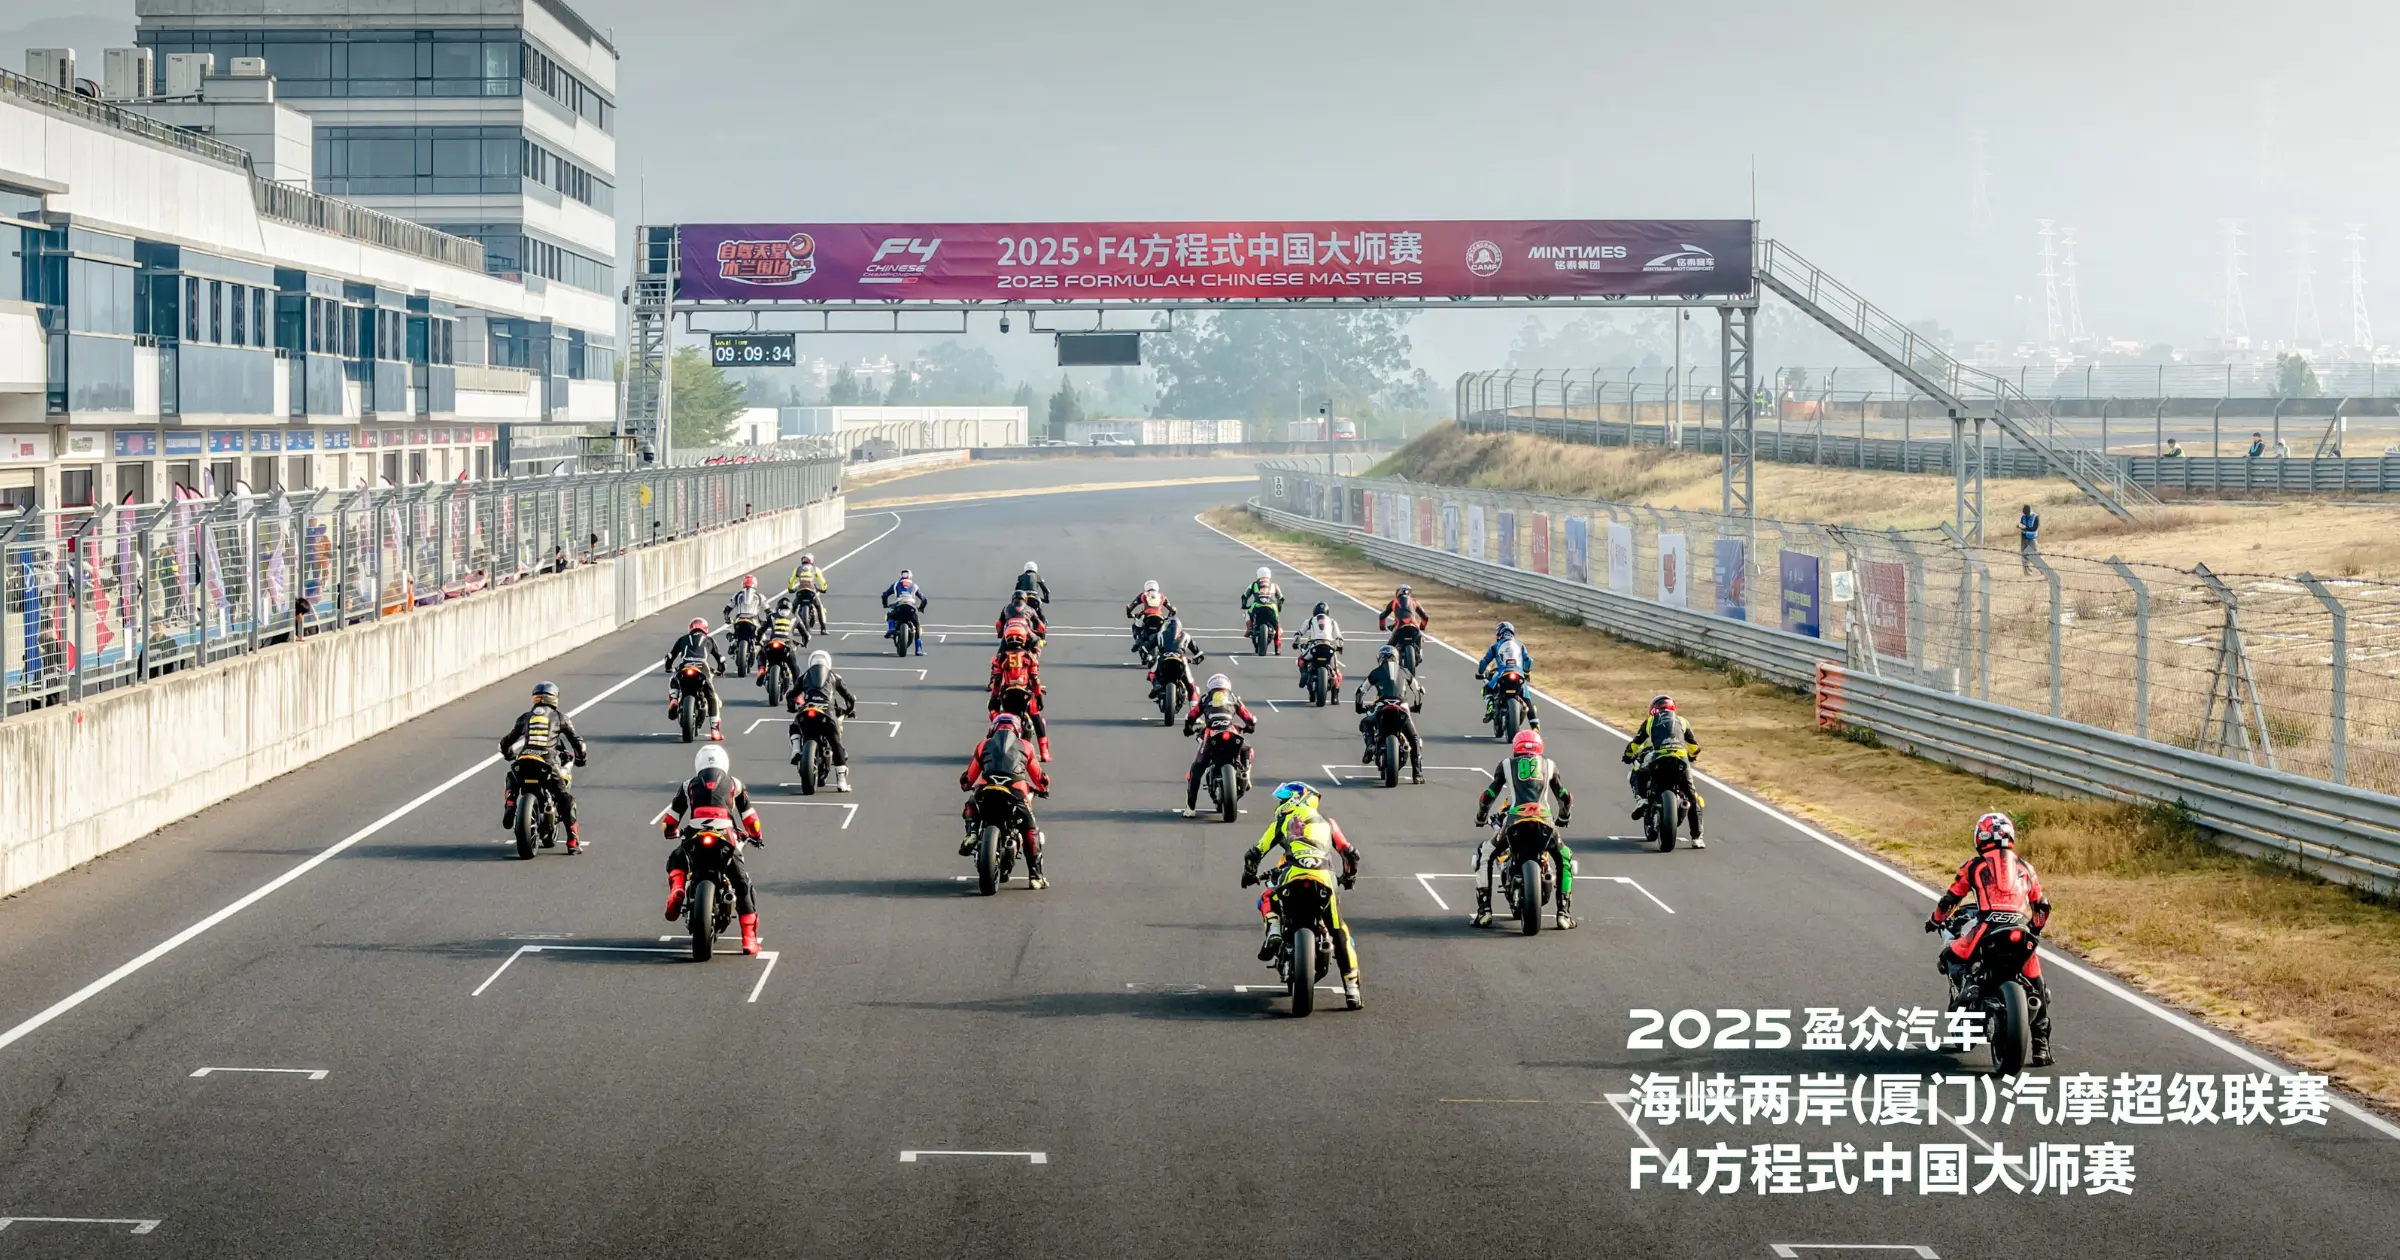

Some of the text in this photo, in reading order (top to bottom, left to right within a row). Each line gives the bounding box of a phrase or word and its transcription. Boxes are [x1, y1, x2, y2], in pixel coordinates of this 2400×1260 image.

[871, 238, 943, 263] F4
[997, 231, 1423, 267] 2025·F4方程式中国大师赛
[1527, 246, 1627, 258] MINTIMES
[866, 264, 927, 272] CHINESE
[997, 271, 1423, 288] 2025 FORMULA4 CHINESE MASTERS
[716, 346, 792, 361] 09:09:34
[1009, 653, 1023, 668] 51
[1517, 757, 1544, 780] 92
[1985, 911, 2024, 924] RST
